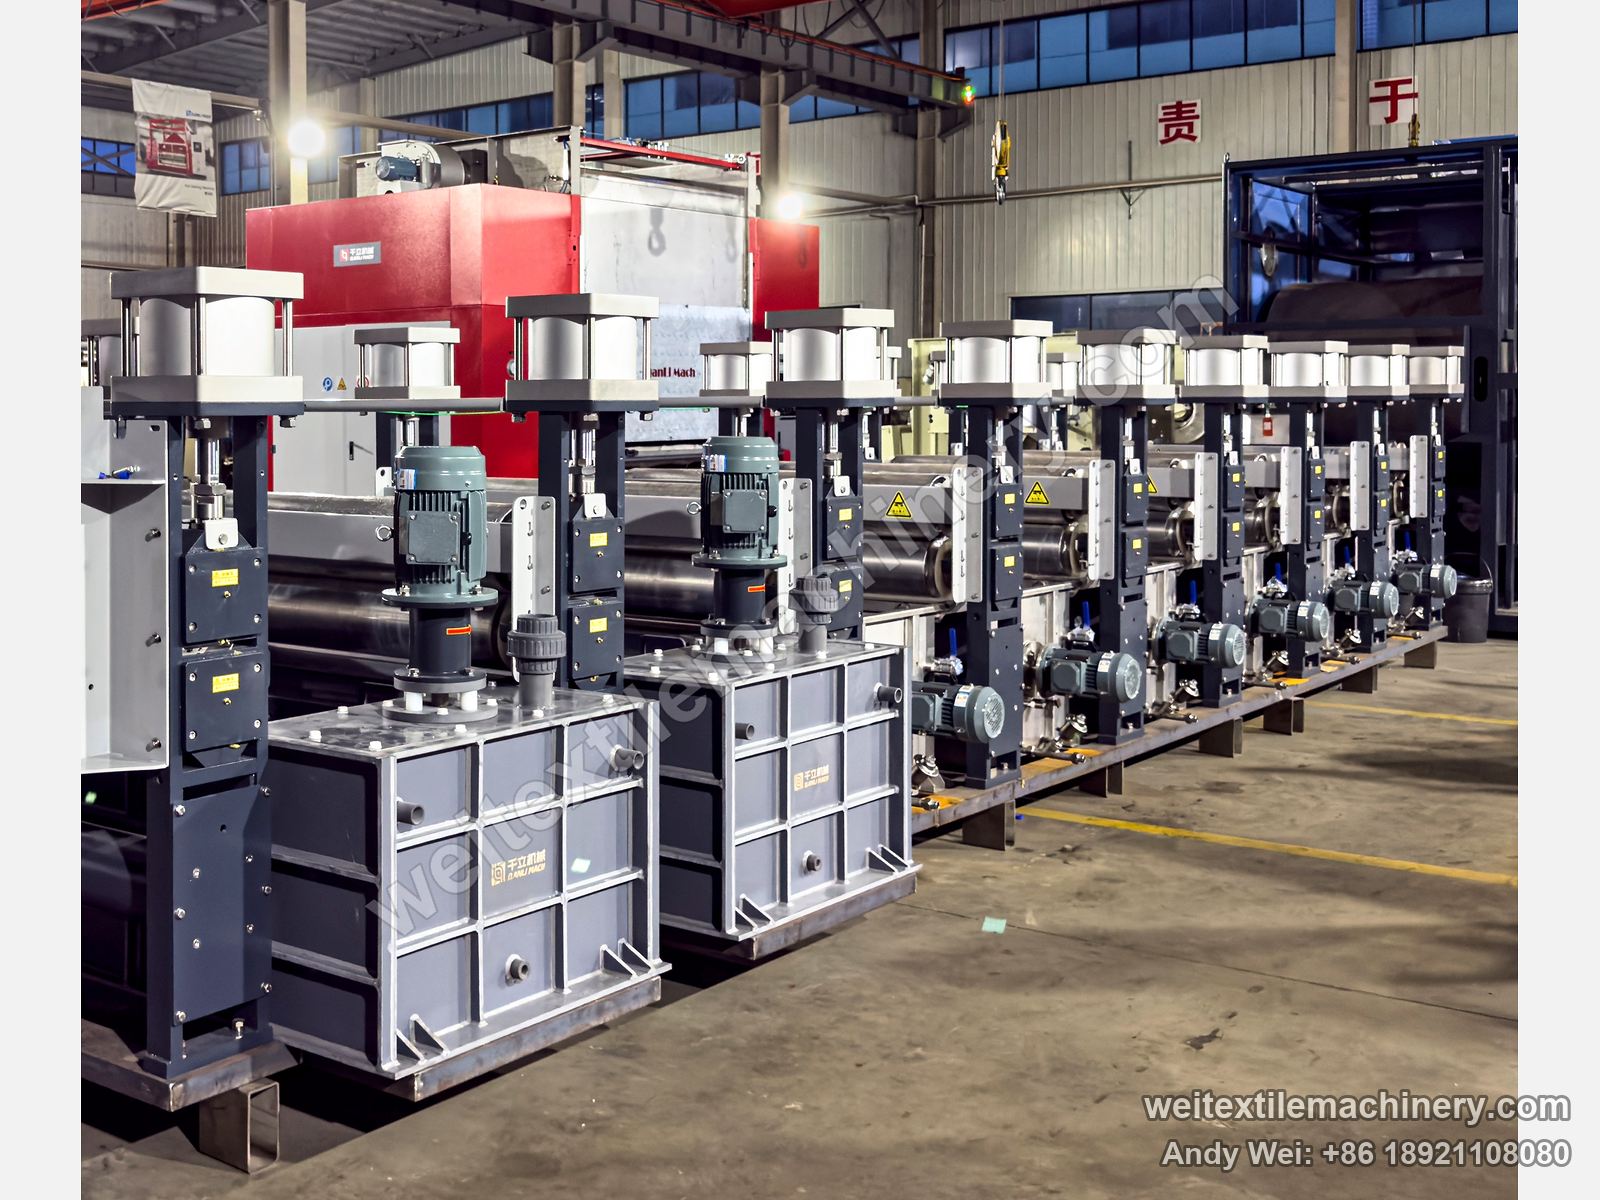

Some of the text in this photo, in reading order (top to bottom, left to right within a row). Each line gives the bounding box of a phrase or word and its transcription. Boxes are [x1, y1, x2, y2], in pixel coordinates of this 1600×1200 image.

[1369, 78, 1419, 124] 于
[1158, 101, 1200, 145] 责
[673, 367, 696, 378] Mach
[507, 848, 546, 871] 千立机械
